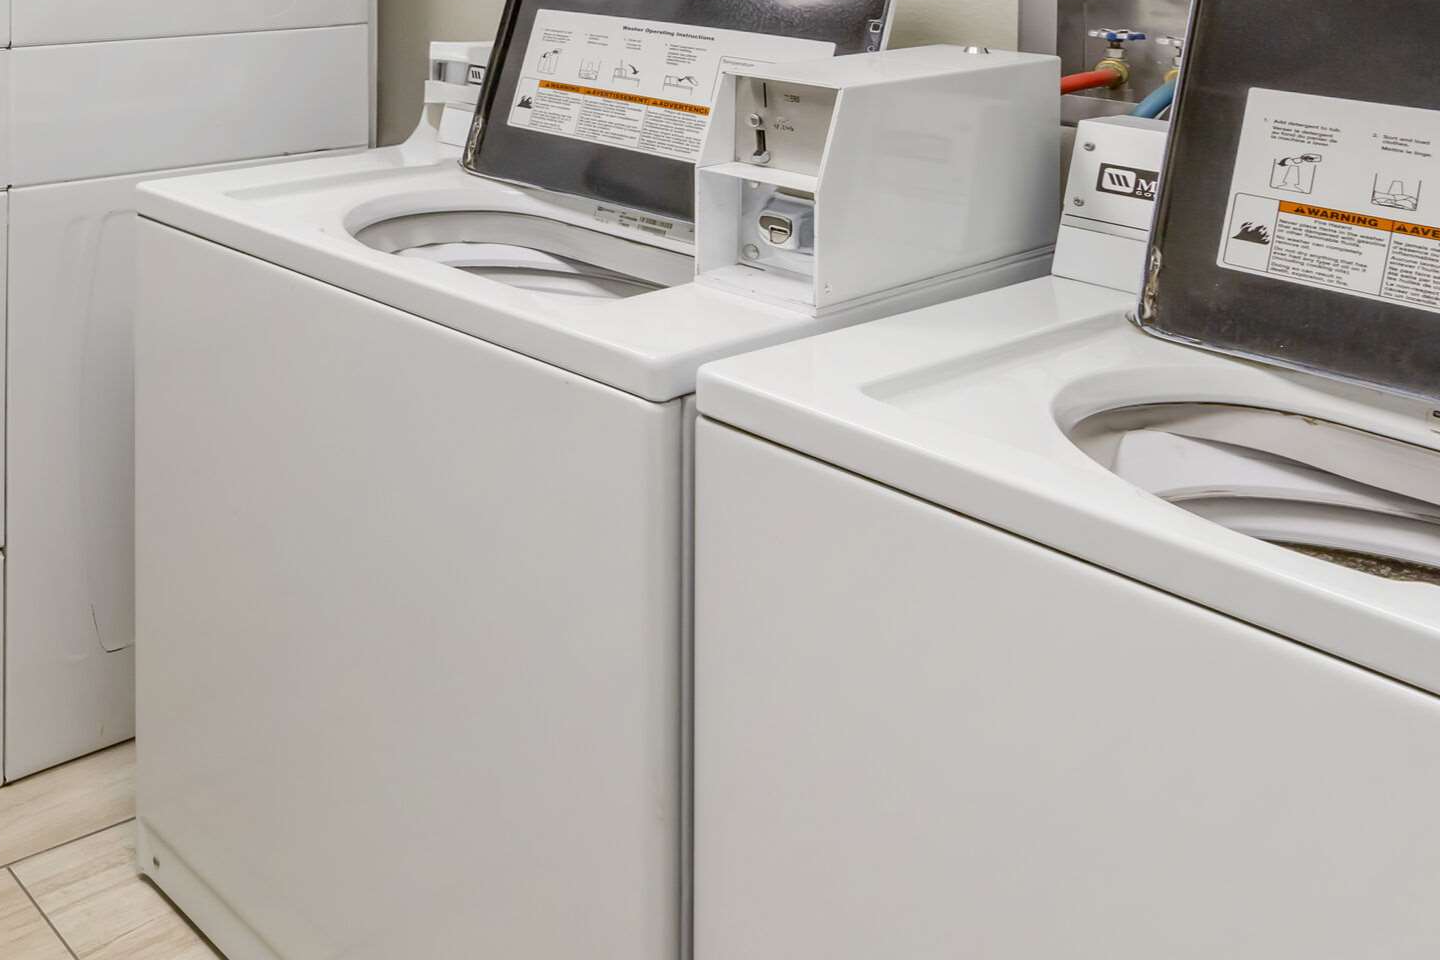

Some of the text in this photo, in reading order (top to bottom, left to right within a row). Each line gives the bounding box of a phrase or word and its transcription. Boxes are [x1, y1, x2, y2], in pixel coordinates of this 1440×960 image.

[645, 27, 675, 37] Operating
[1308, 208, 1378, 227] WARNING
[1410, 225, 1440, 239] AVE
